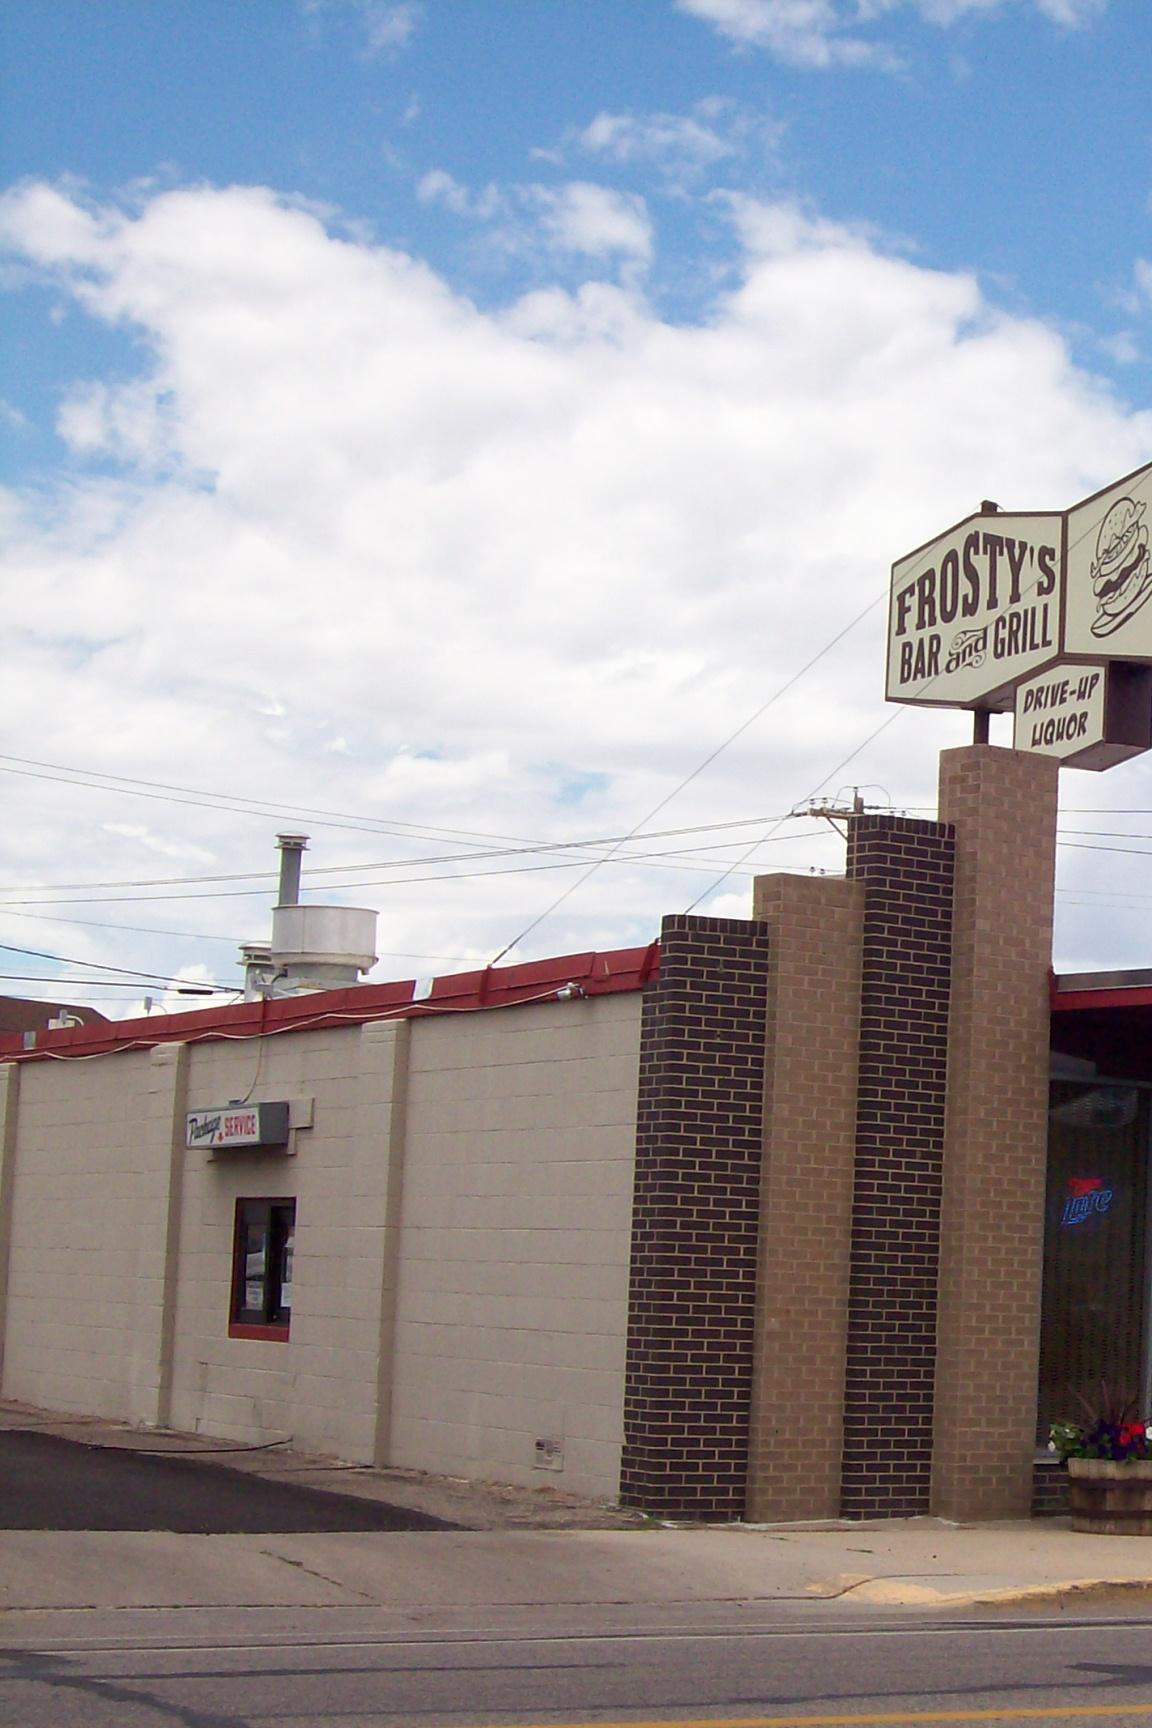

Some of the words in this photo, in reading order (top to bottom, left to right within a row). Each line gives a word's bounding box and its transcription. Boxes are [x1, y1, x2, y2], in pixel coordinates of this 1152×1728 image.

[896, 530, 1056, 637] FROSTY'S
[900, 634, 941, 684] BAR
[945, 626, 988, 675] and
[993, 602, 1053, 660] GRILL
[1023, 672, 1100, 715] DRIVE-UP
[1031, 711, 1089, 748] LIQUOR
[224, 1114, 256, 1137] SERVICE
